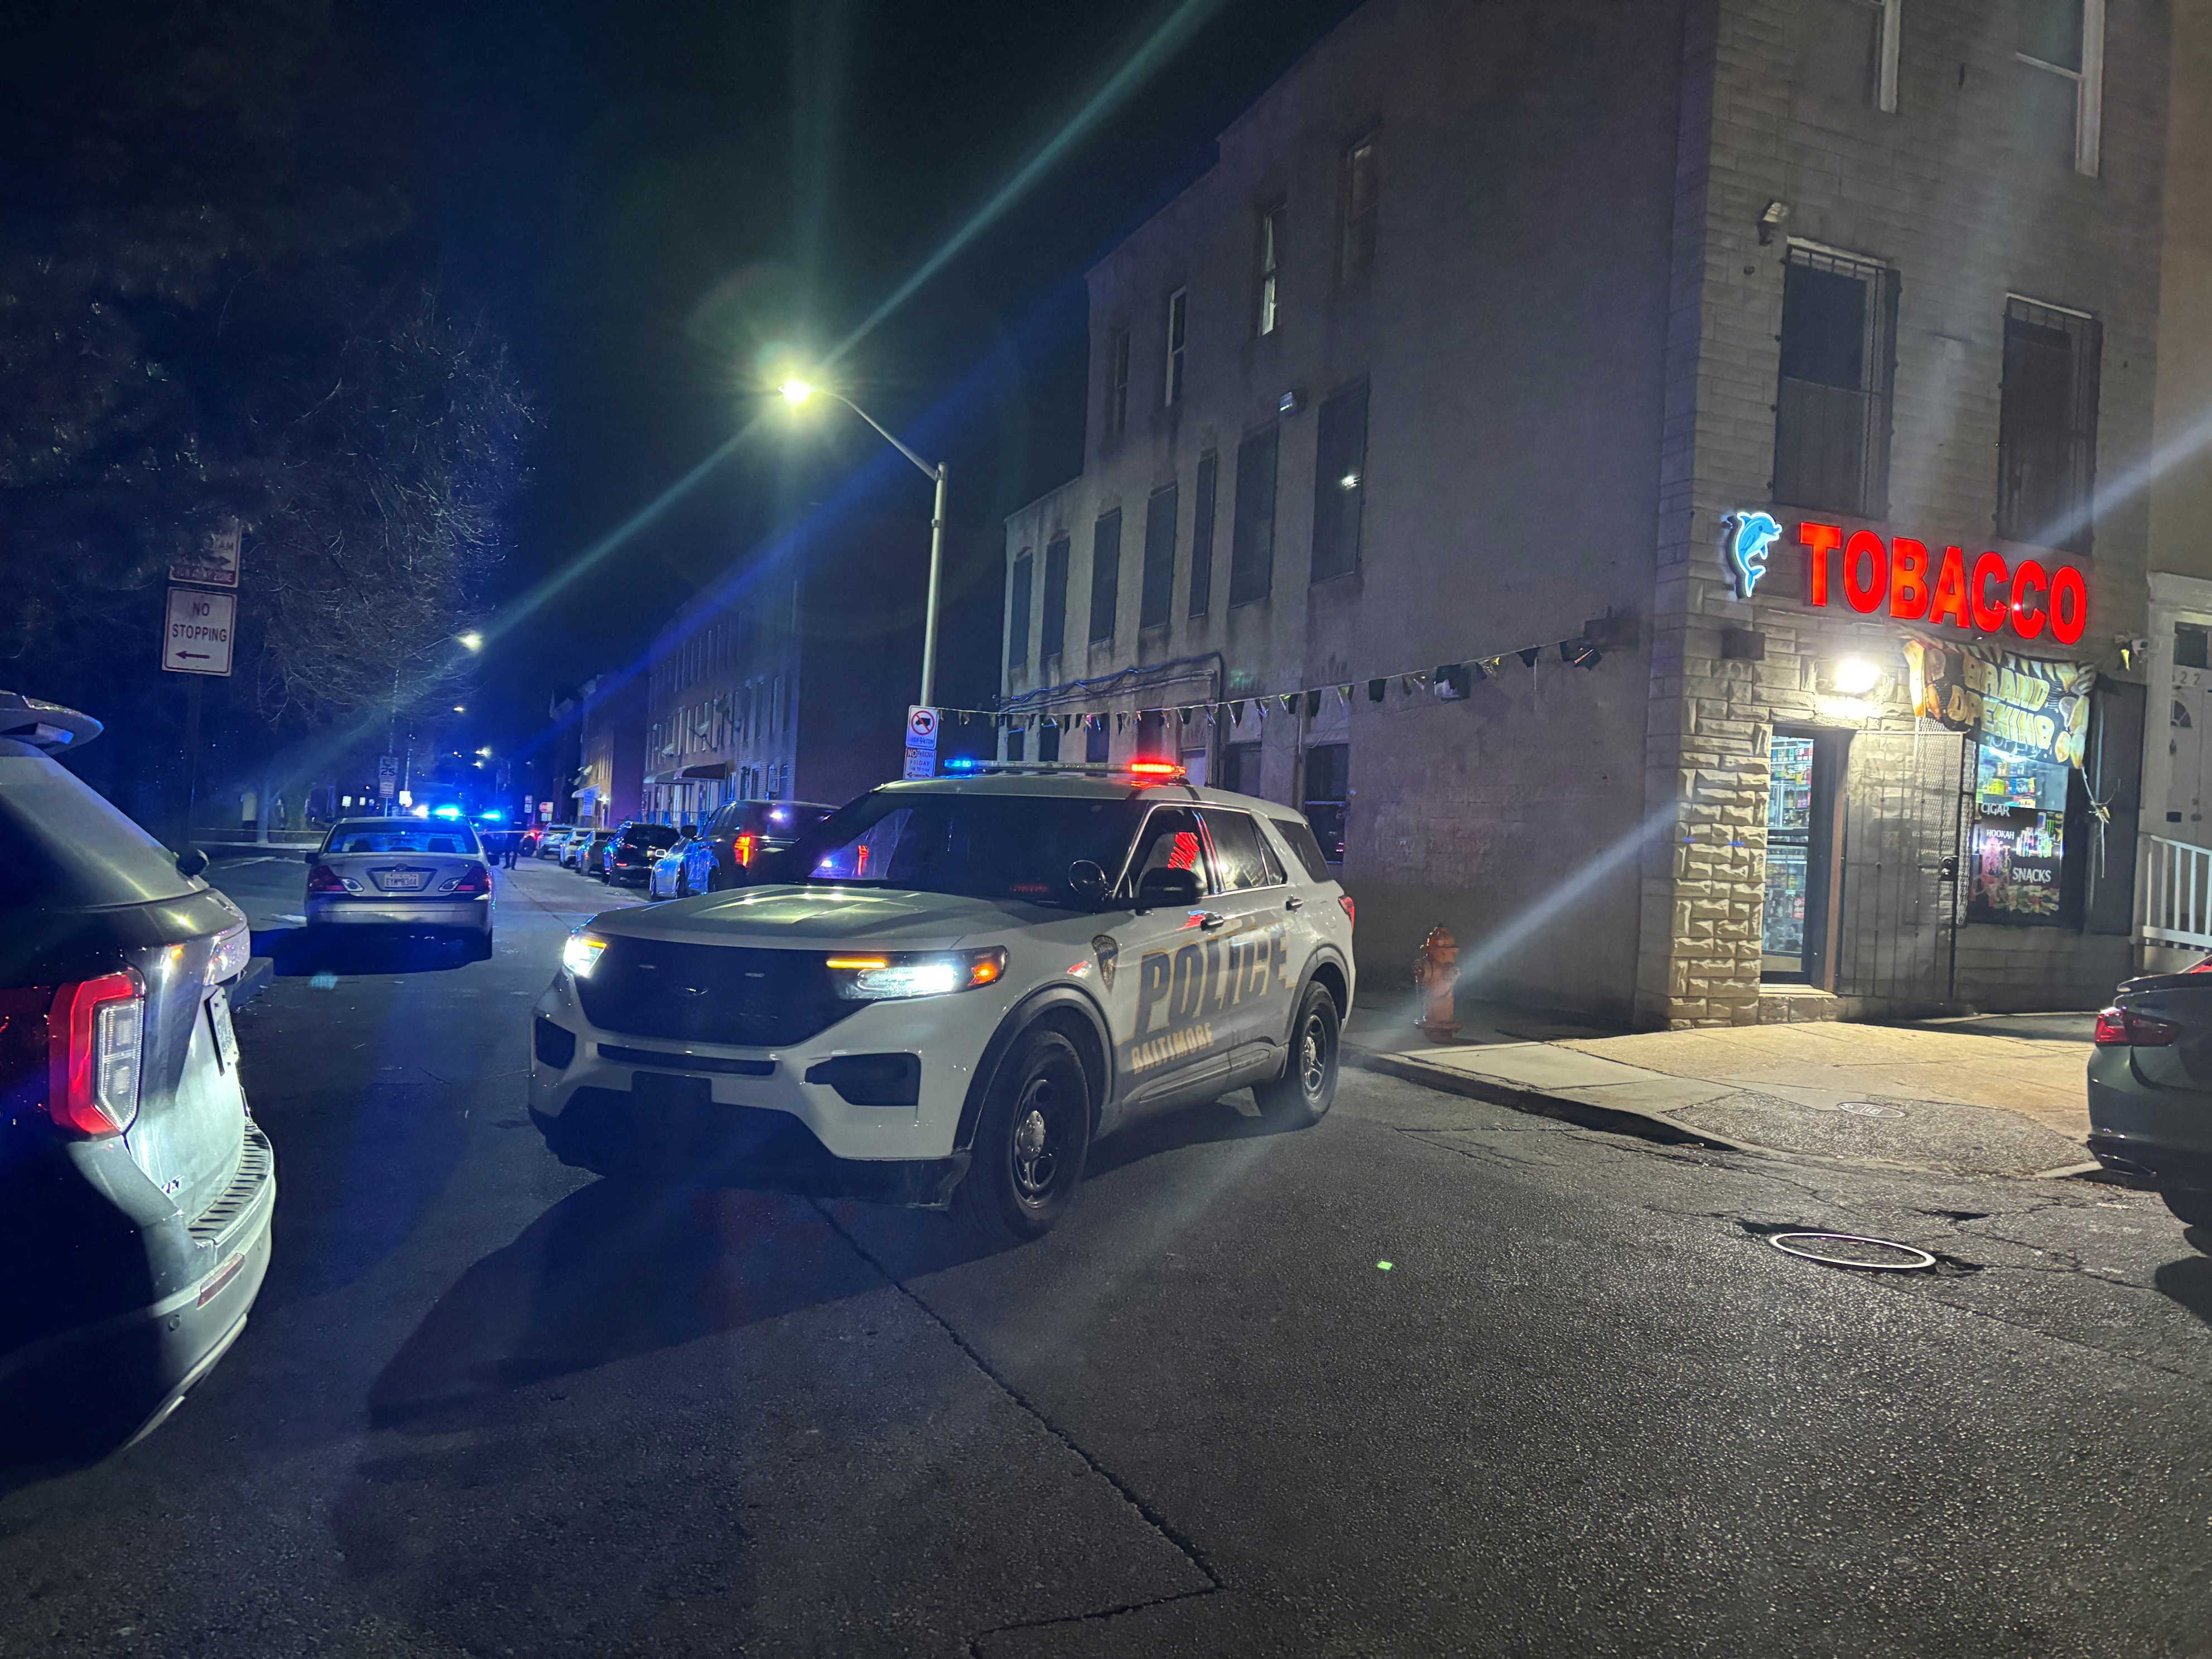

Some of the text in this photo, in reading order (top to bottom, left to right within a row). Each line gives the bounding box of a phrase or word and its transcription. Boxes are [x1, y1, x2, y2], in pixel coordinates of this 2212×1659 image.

[1799, 522, 2087, 645] TOBACCO
[192, 602, 210, 616] NO
[172, 623, 227, 643] STOPPING
[907, 749, 917, 758] NO
[381, 767, 396, 776] 25
[1981, 802, 2010, 817] CIGAR
[1986, 829, 2015, 840] HOOKAH
[2012, 867, 2052, 884] SNACKS
[1132, 922, 1295, 1036] POLICE
[1131, 1022, 1215, 1074] BALTIMORE
